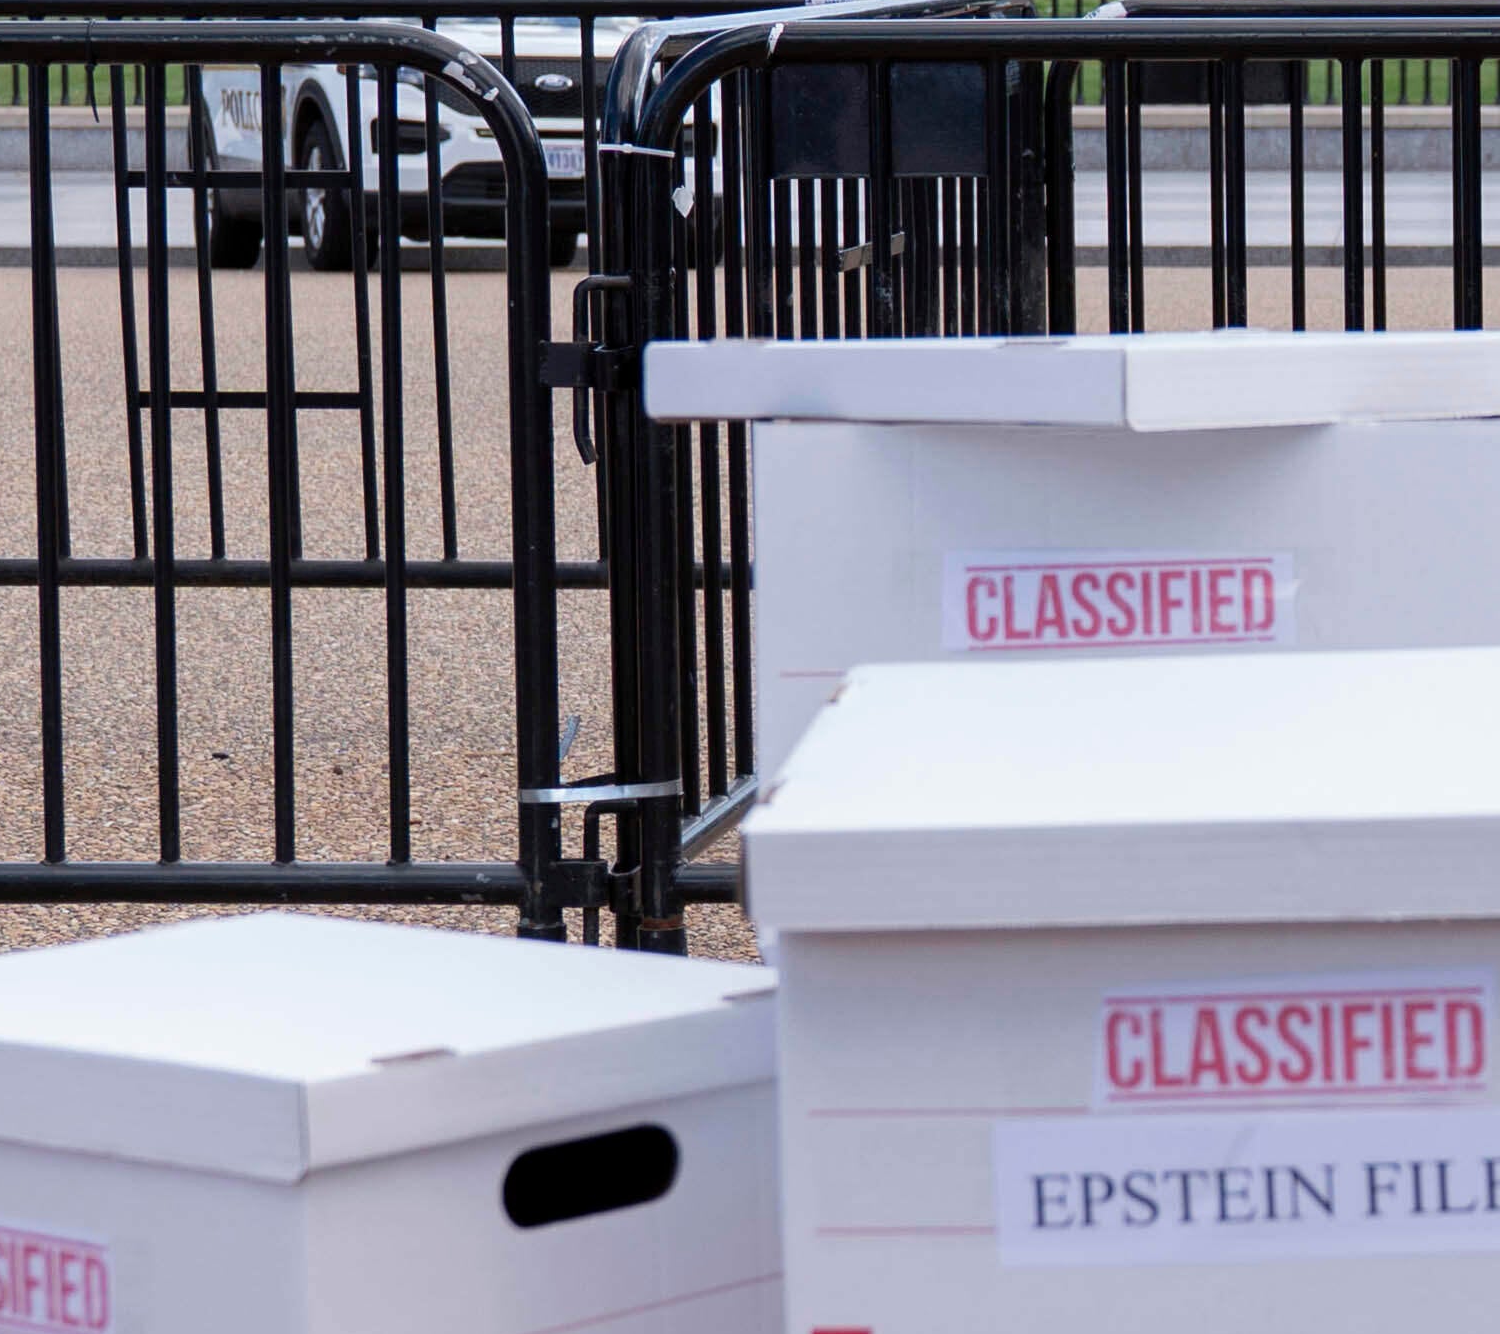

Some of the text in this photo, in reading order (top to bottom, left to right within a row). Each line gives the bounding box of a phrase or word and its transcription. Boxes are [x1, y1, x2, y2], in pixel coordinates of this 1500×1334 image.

[220, 86, 287, 137] POLIC
[965, 567, 1276, 643] CLASSIFIED
[1104, 1001, 1486, 1090] CLASSIFIED
[1031, 1165, 1338, 1230] EPSTEIN
